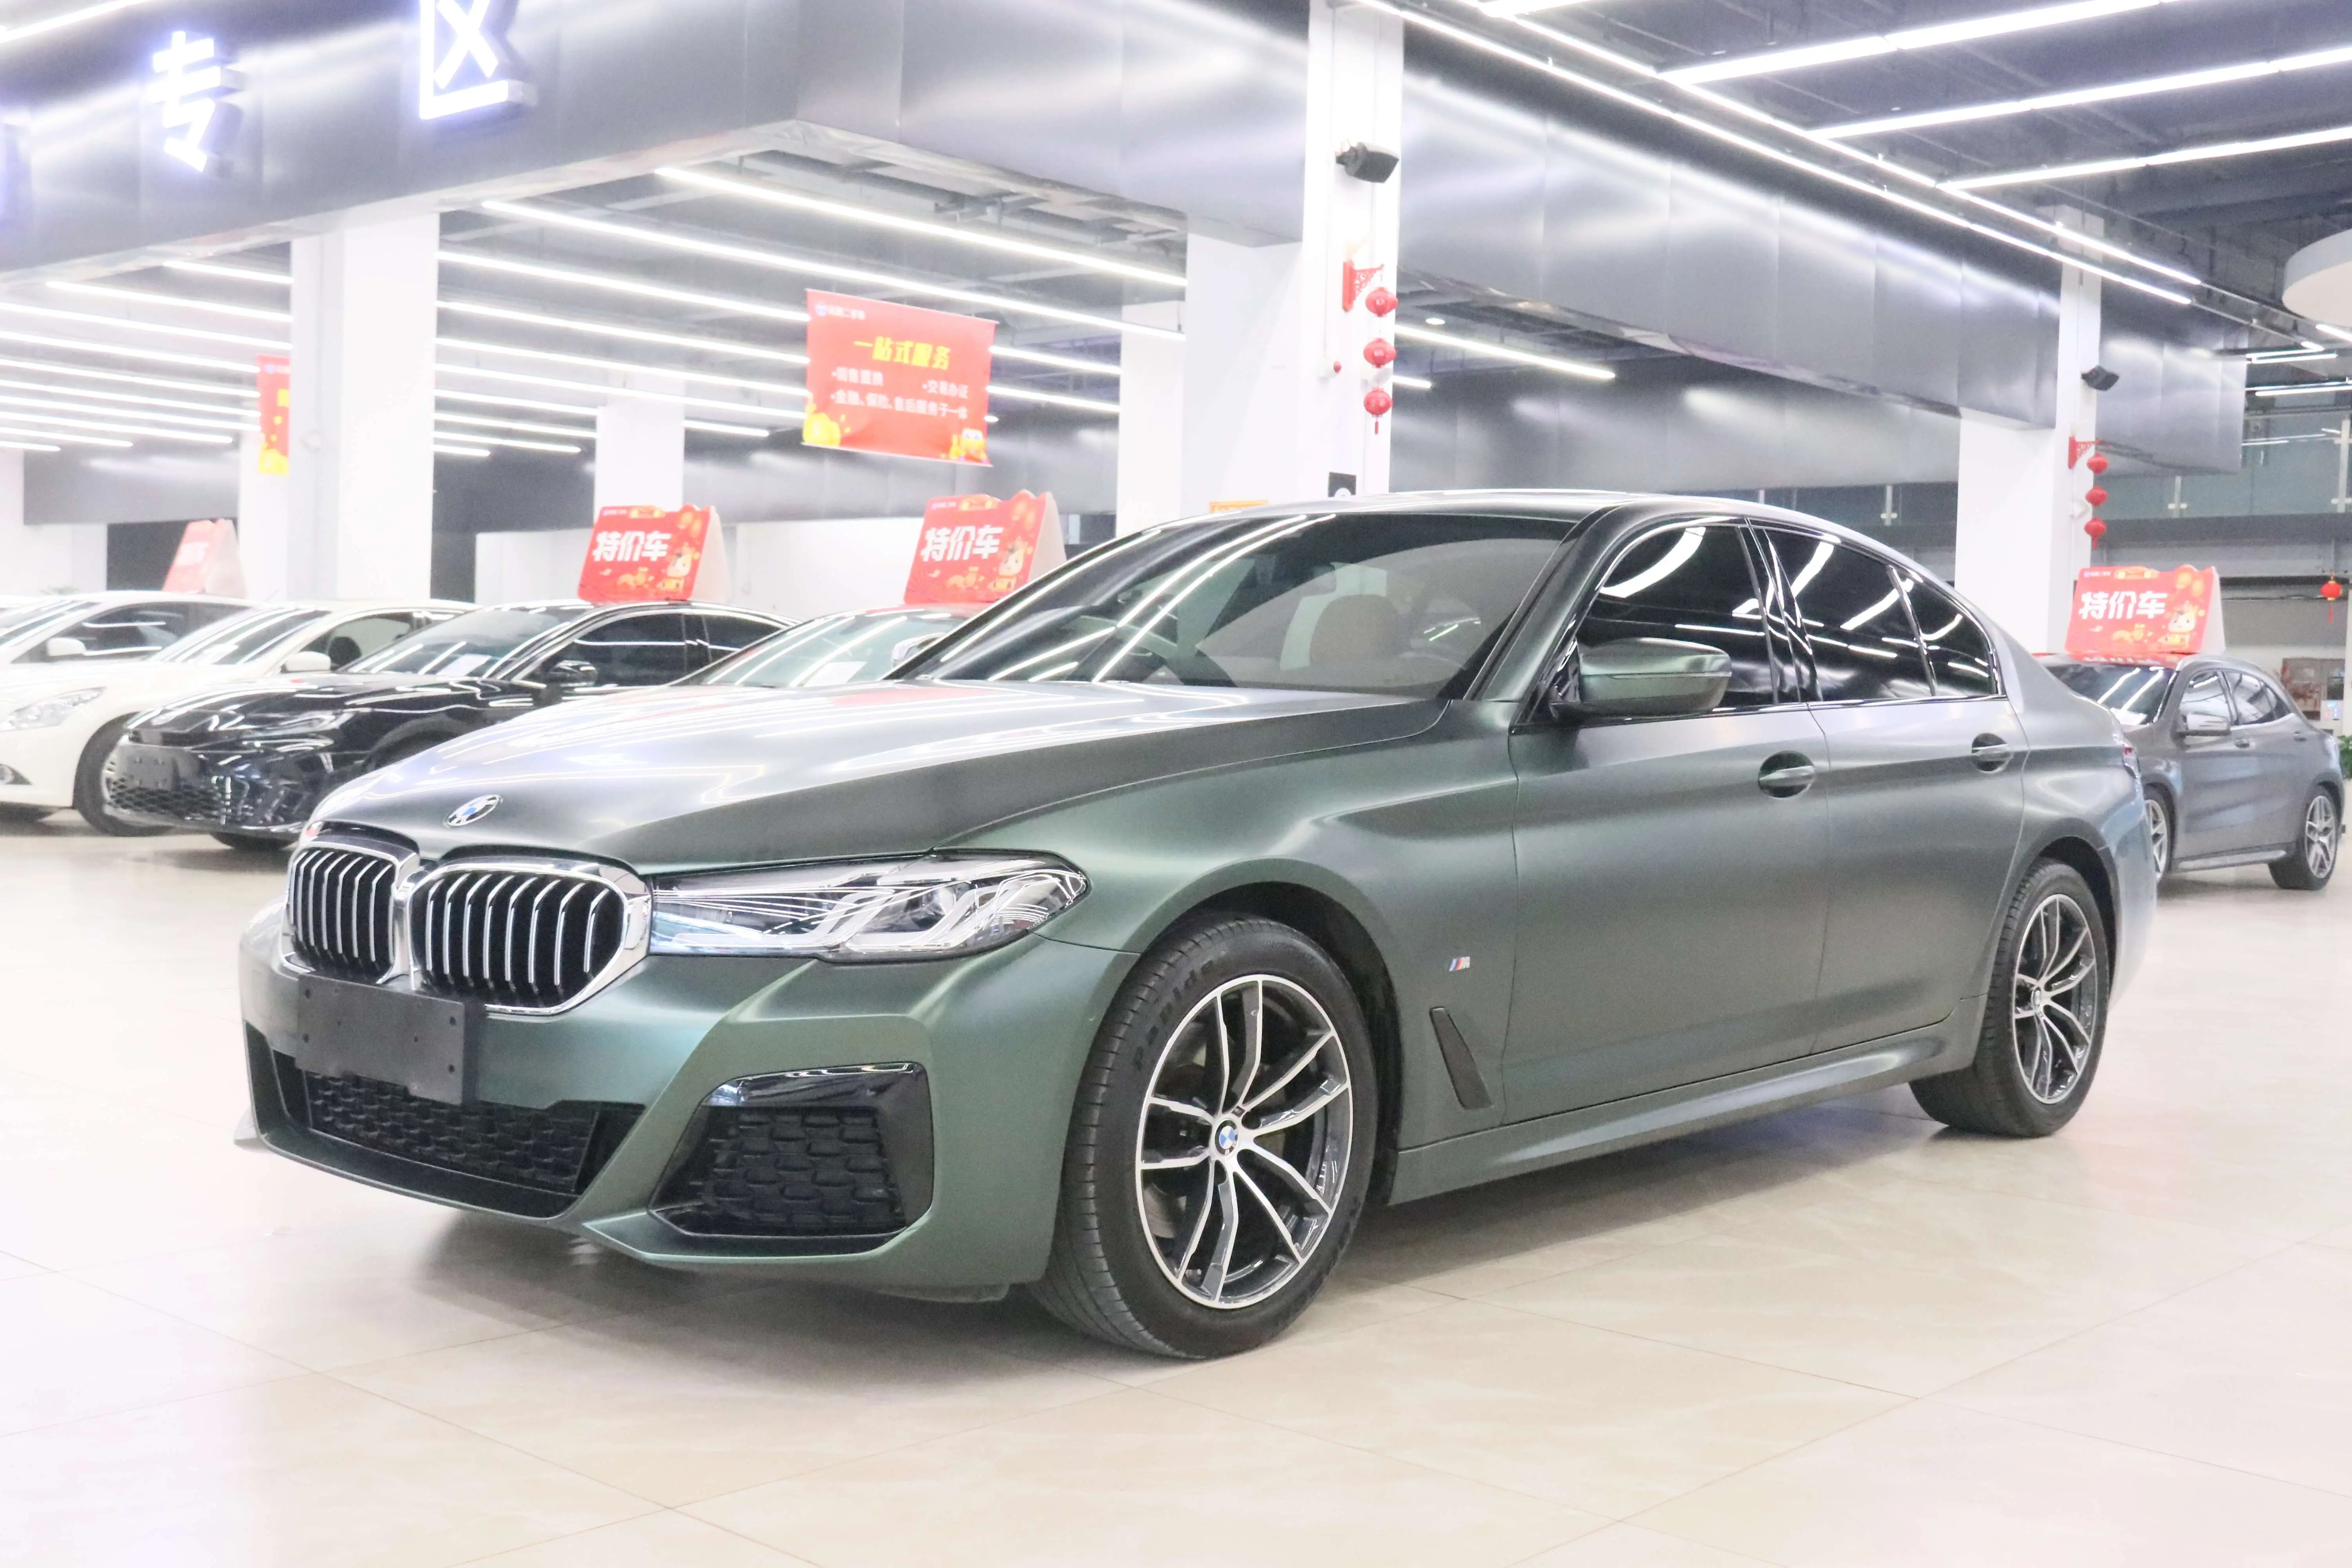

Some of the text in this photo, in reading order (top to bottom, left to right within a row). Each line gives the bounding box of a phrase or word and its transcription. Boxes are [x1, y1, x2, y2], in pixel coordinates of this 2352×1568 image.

[853, 336, 951, 370] 一站式服务
[593, 532, 670, 561] 特价车
[921, 525, 1003, 561] 特价车
[2078, 590, 2168, 619] 特价车
